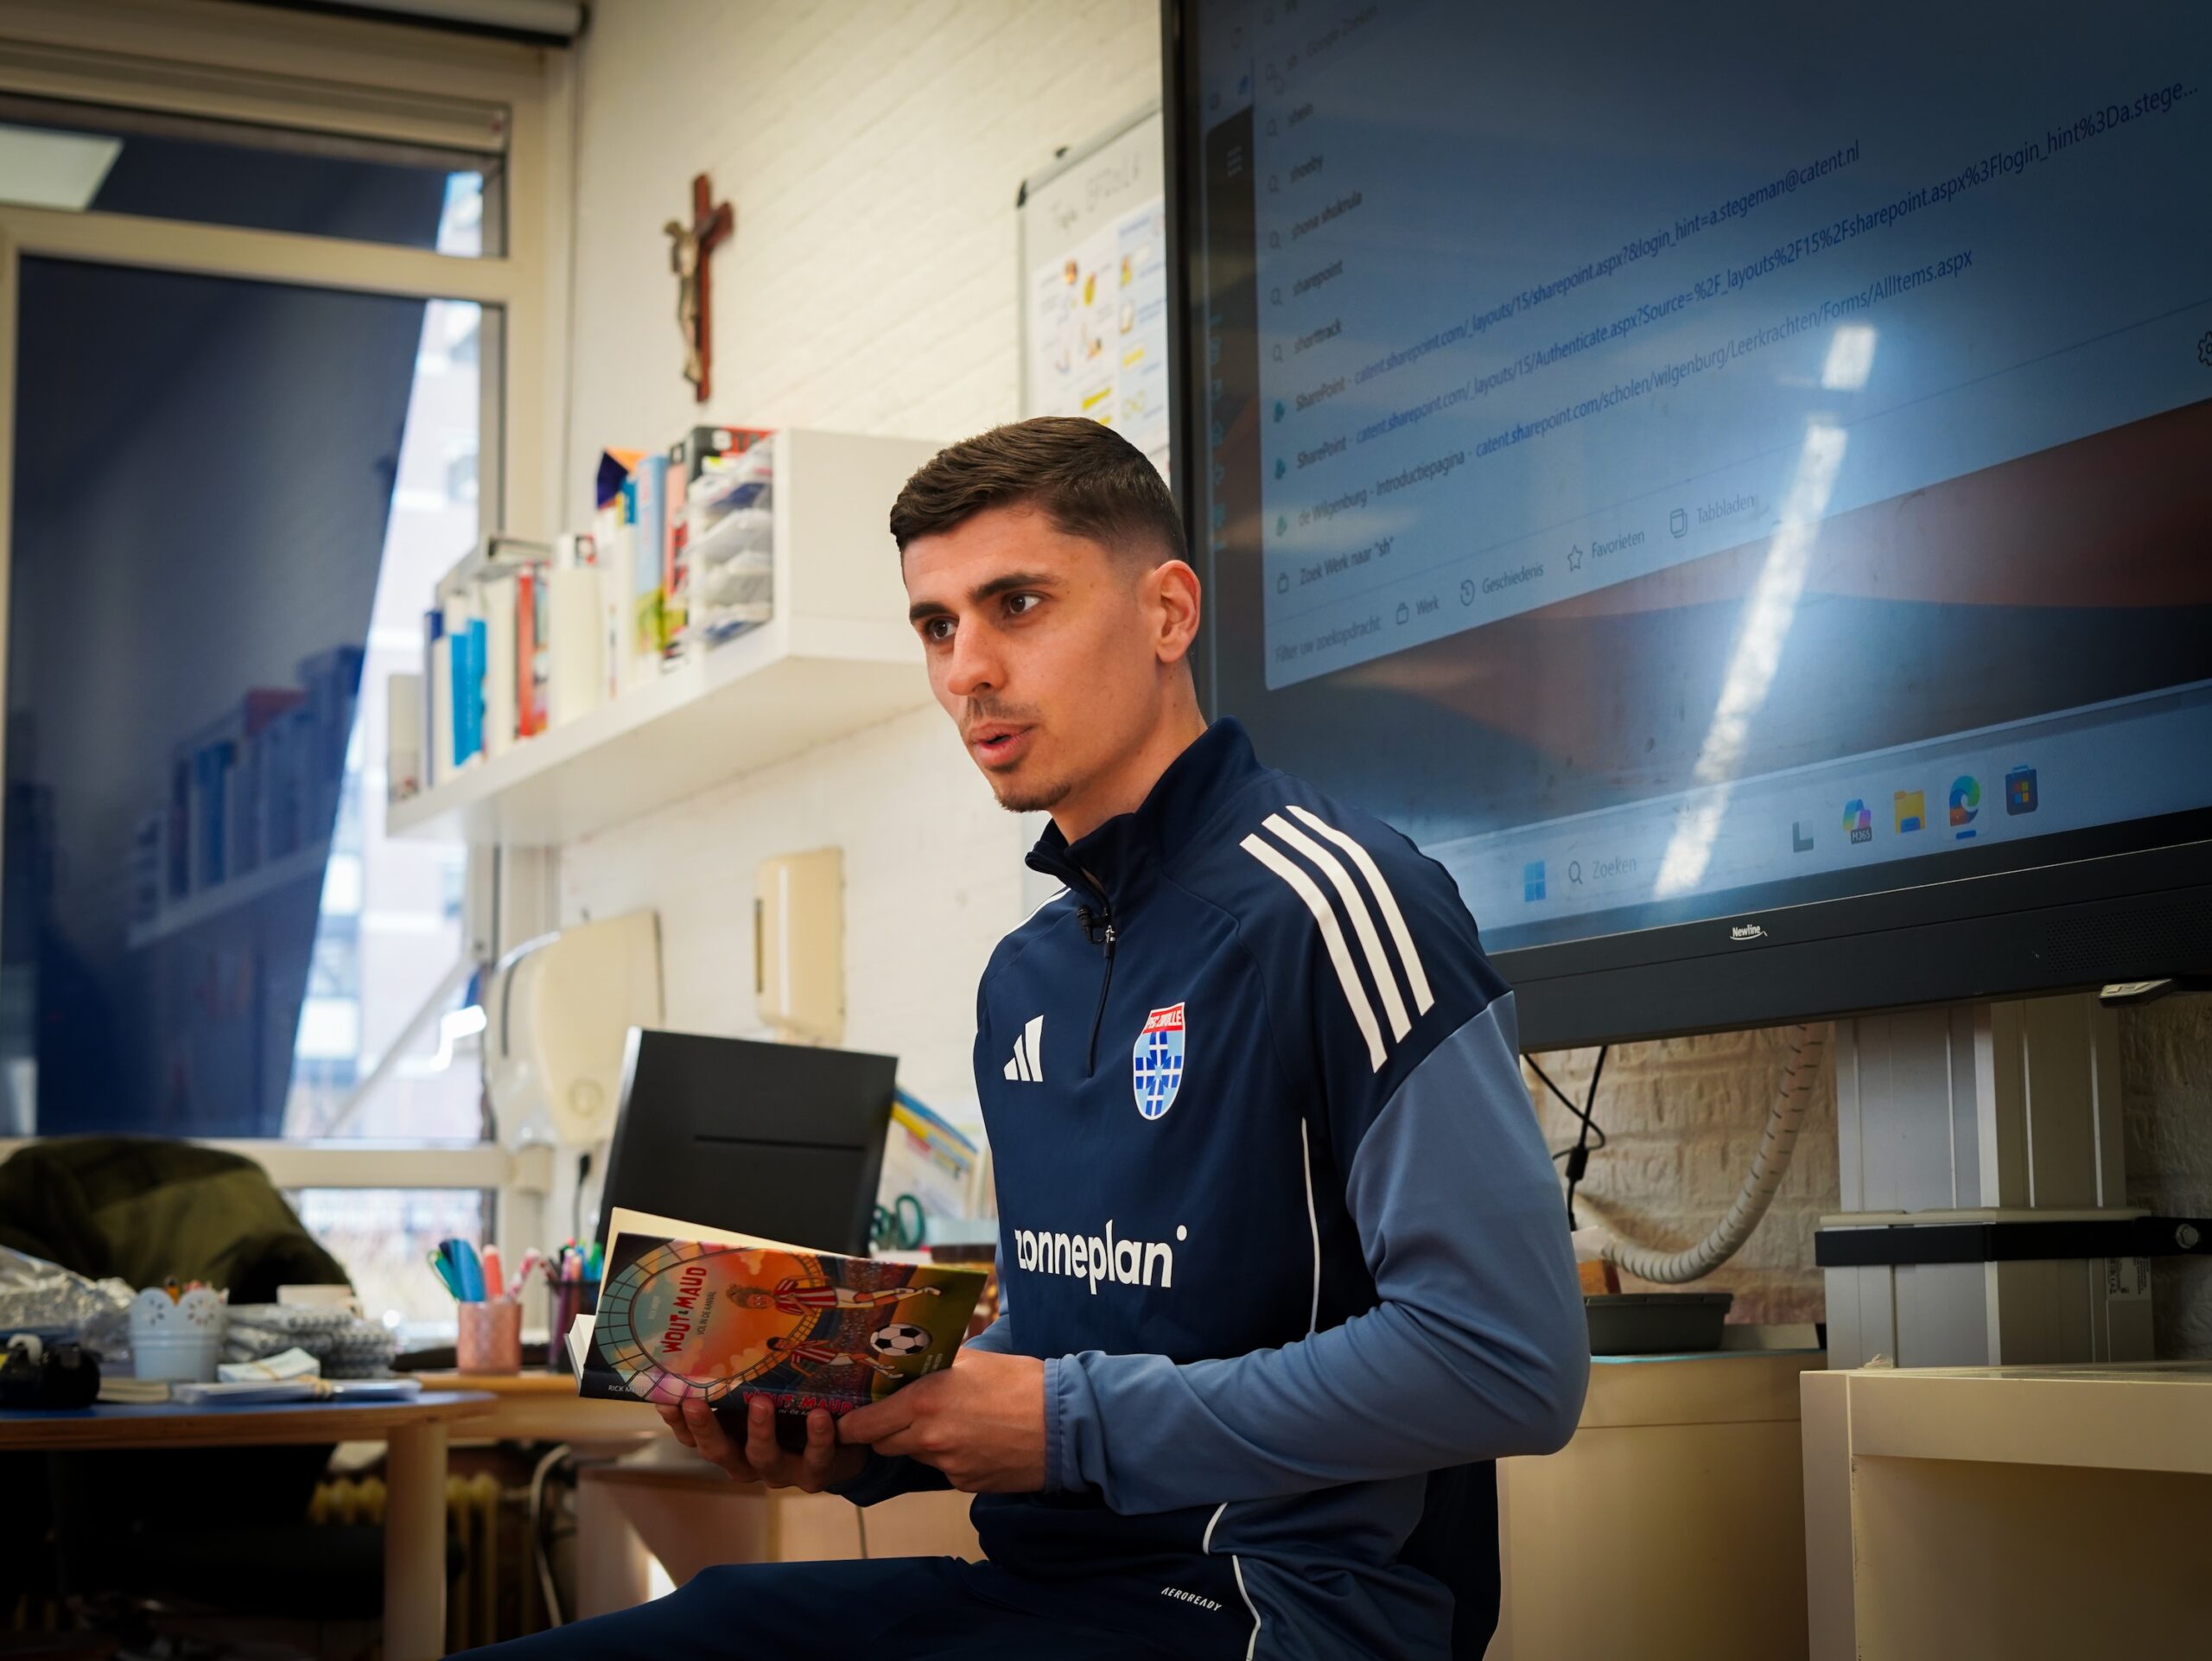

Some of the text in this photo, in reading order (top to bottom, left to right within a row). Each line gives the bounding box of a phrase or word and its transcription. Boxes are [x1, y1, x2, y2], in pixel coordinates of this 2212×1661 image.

[1292, 259, 1344, 298] sharepoint
[1296, 376, 1346, 412] SharePoint
[1297, 436, 1347, 470] SharePoint
[1312, 487, 1368, 522] Wilgenburg
[1376, 449, 1465, 497] Introductiepagina
[1697, 493, 1756, 525] Tabbladen
[1592, 531, 1646, 559] Favorieten
[1300, 562, 1323, 586] Zoek
[1324, 553, 1348, 576] Werk
[1351, 548, 1372, 567] naar
[1482, 562, 1545, 595] Geschiedenis
[1415, 595, 1440, 616] Werk
[1592, 856, 1639, 881] Zoeken
[1732, 923, 1761, 938] Newline
[1014, 1219, 1174, 1295] zonneplan
[672, 1267, 707, 1309] MAUD
[660, 1314, 691, 1353] WOUT
[608, 1384, 623, 1393] RICK
[1160, 1587, 1223, 1612] AEROREADY
